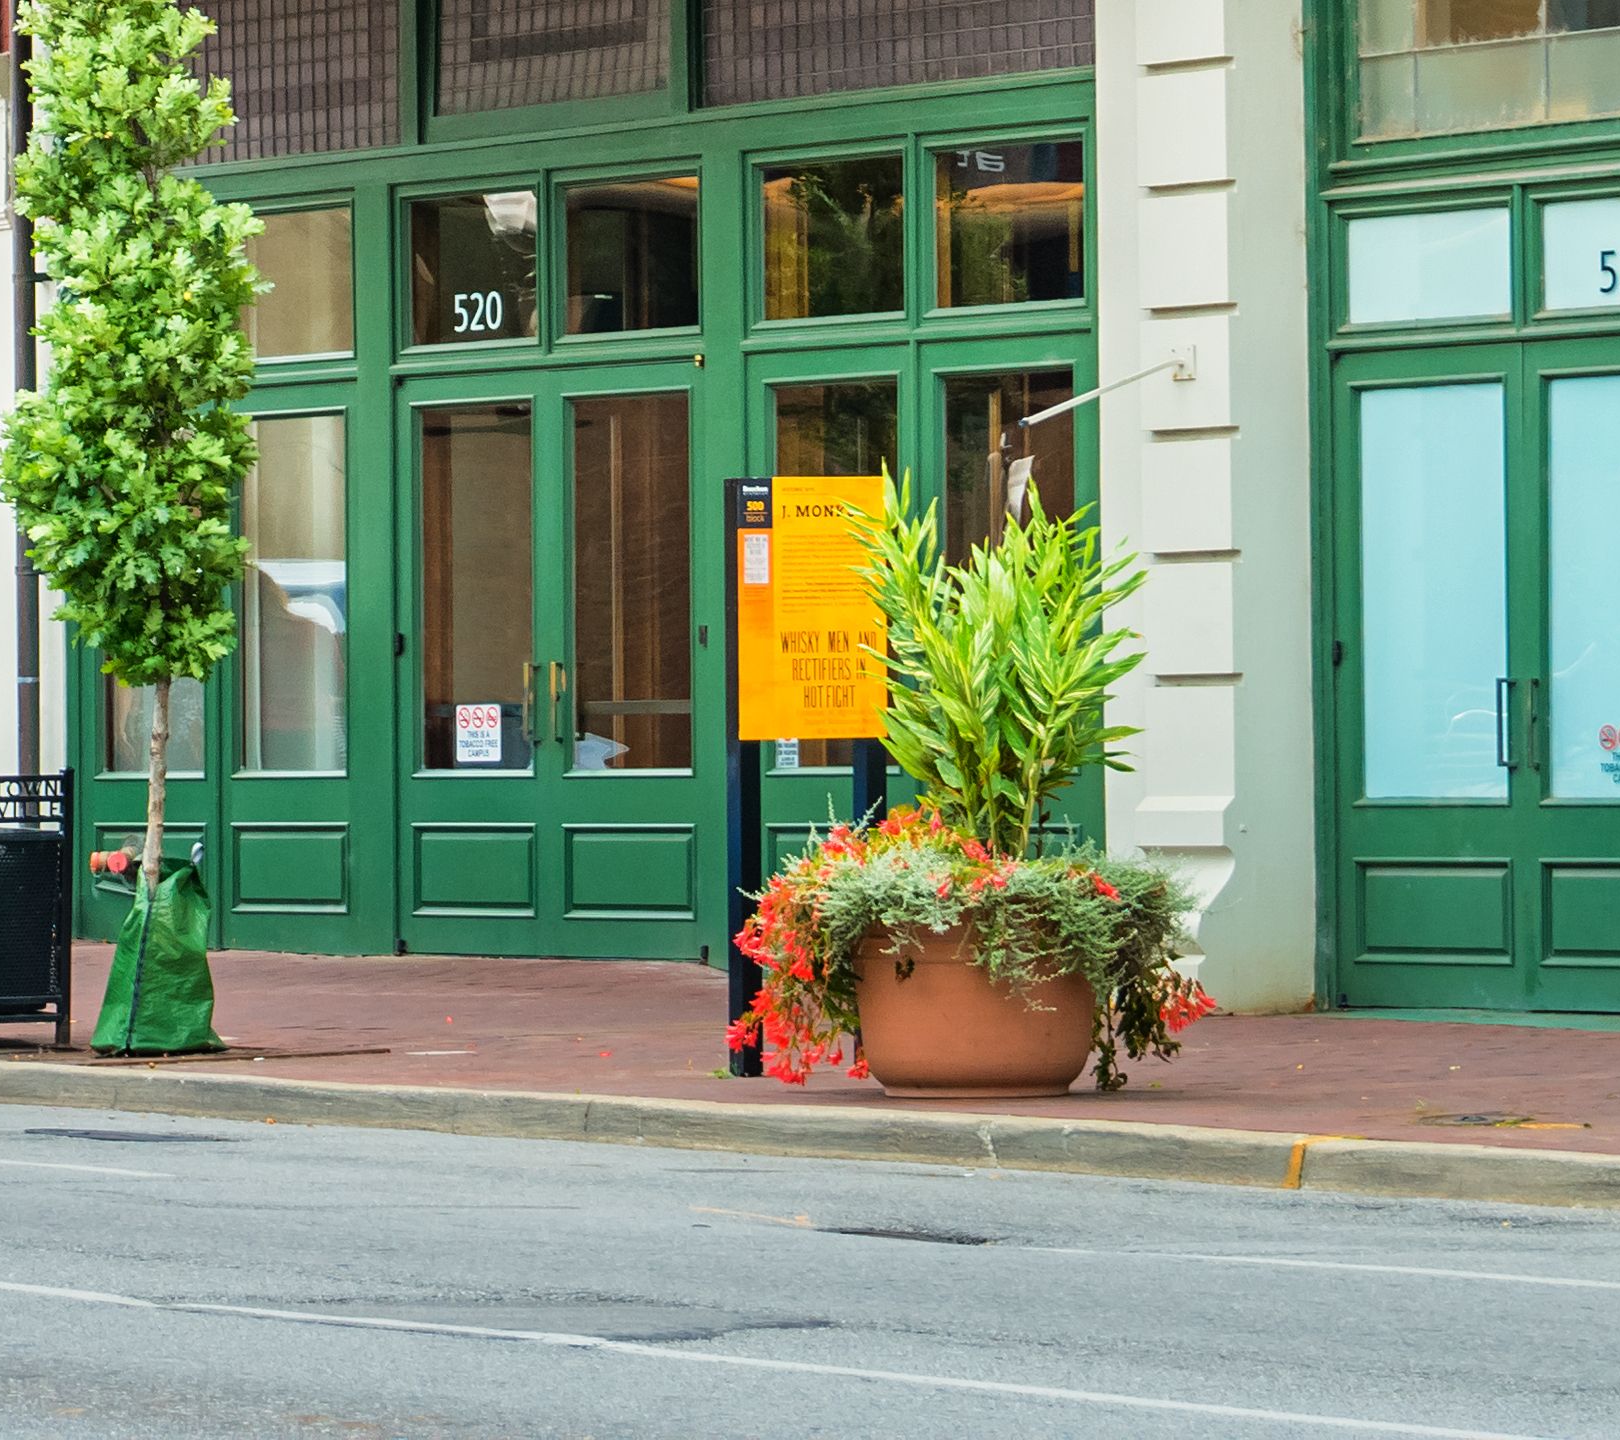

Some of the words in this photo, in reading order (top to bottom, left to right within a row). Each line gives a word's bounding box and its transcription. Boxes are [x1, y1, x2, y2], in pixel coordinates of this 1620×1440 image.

[454, 291, 503, 333] 520
[781, 505, 791, 519] J.
[780, 631, 820, 653] WHISKY
[828, 631, 850, 653] MEN
[792, 658, 851, 681] RECTIFIERS
[856, 658, 866, 680] IN
[804, 685, 824, 708] HOT
[826, 685, 856, 708] FIGHT
